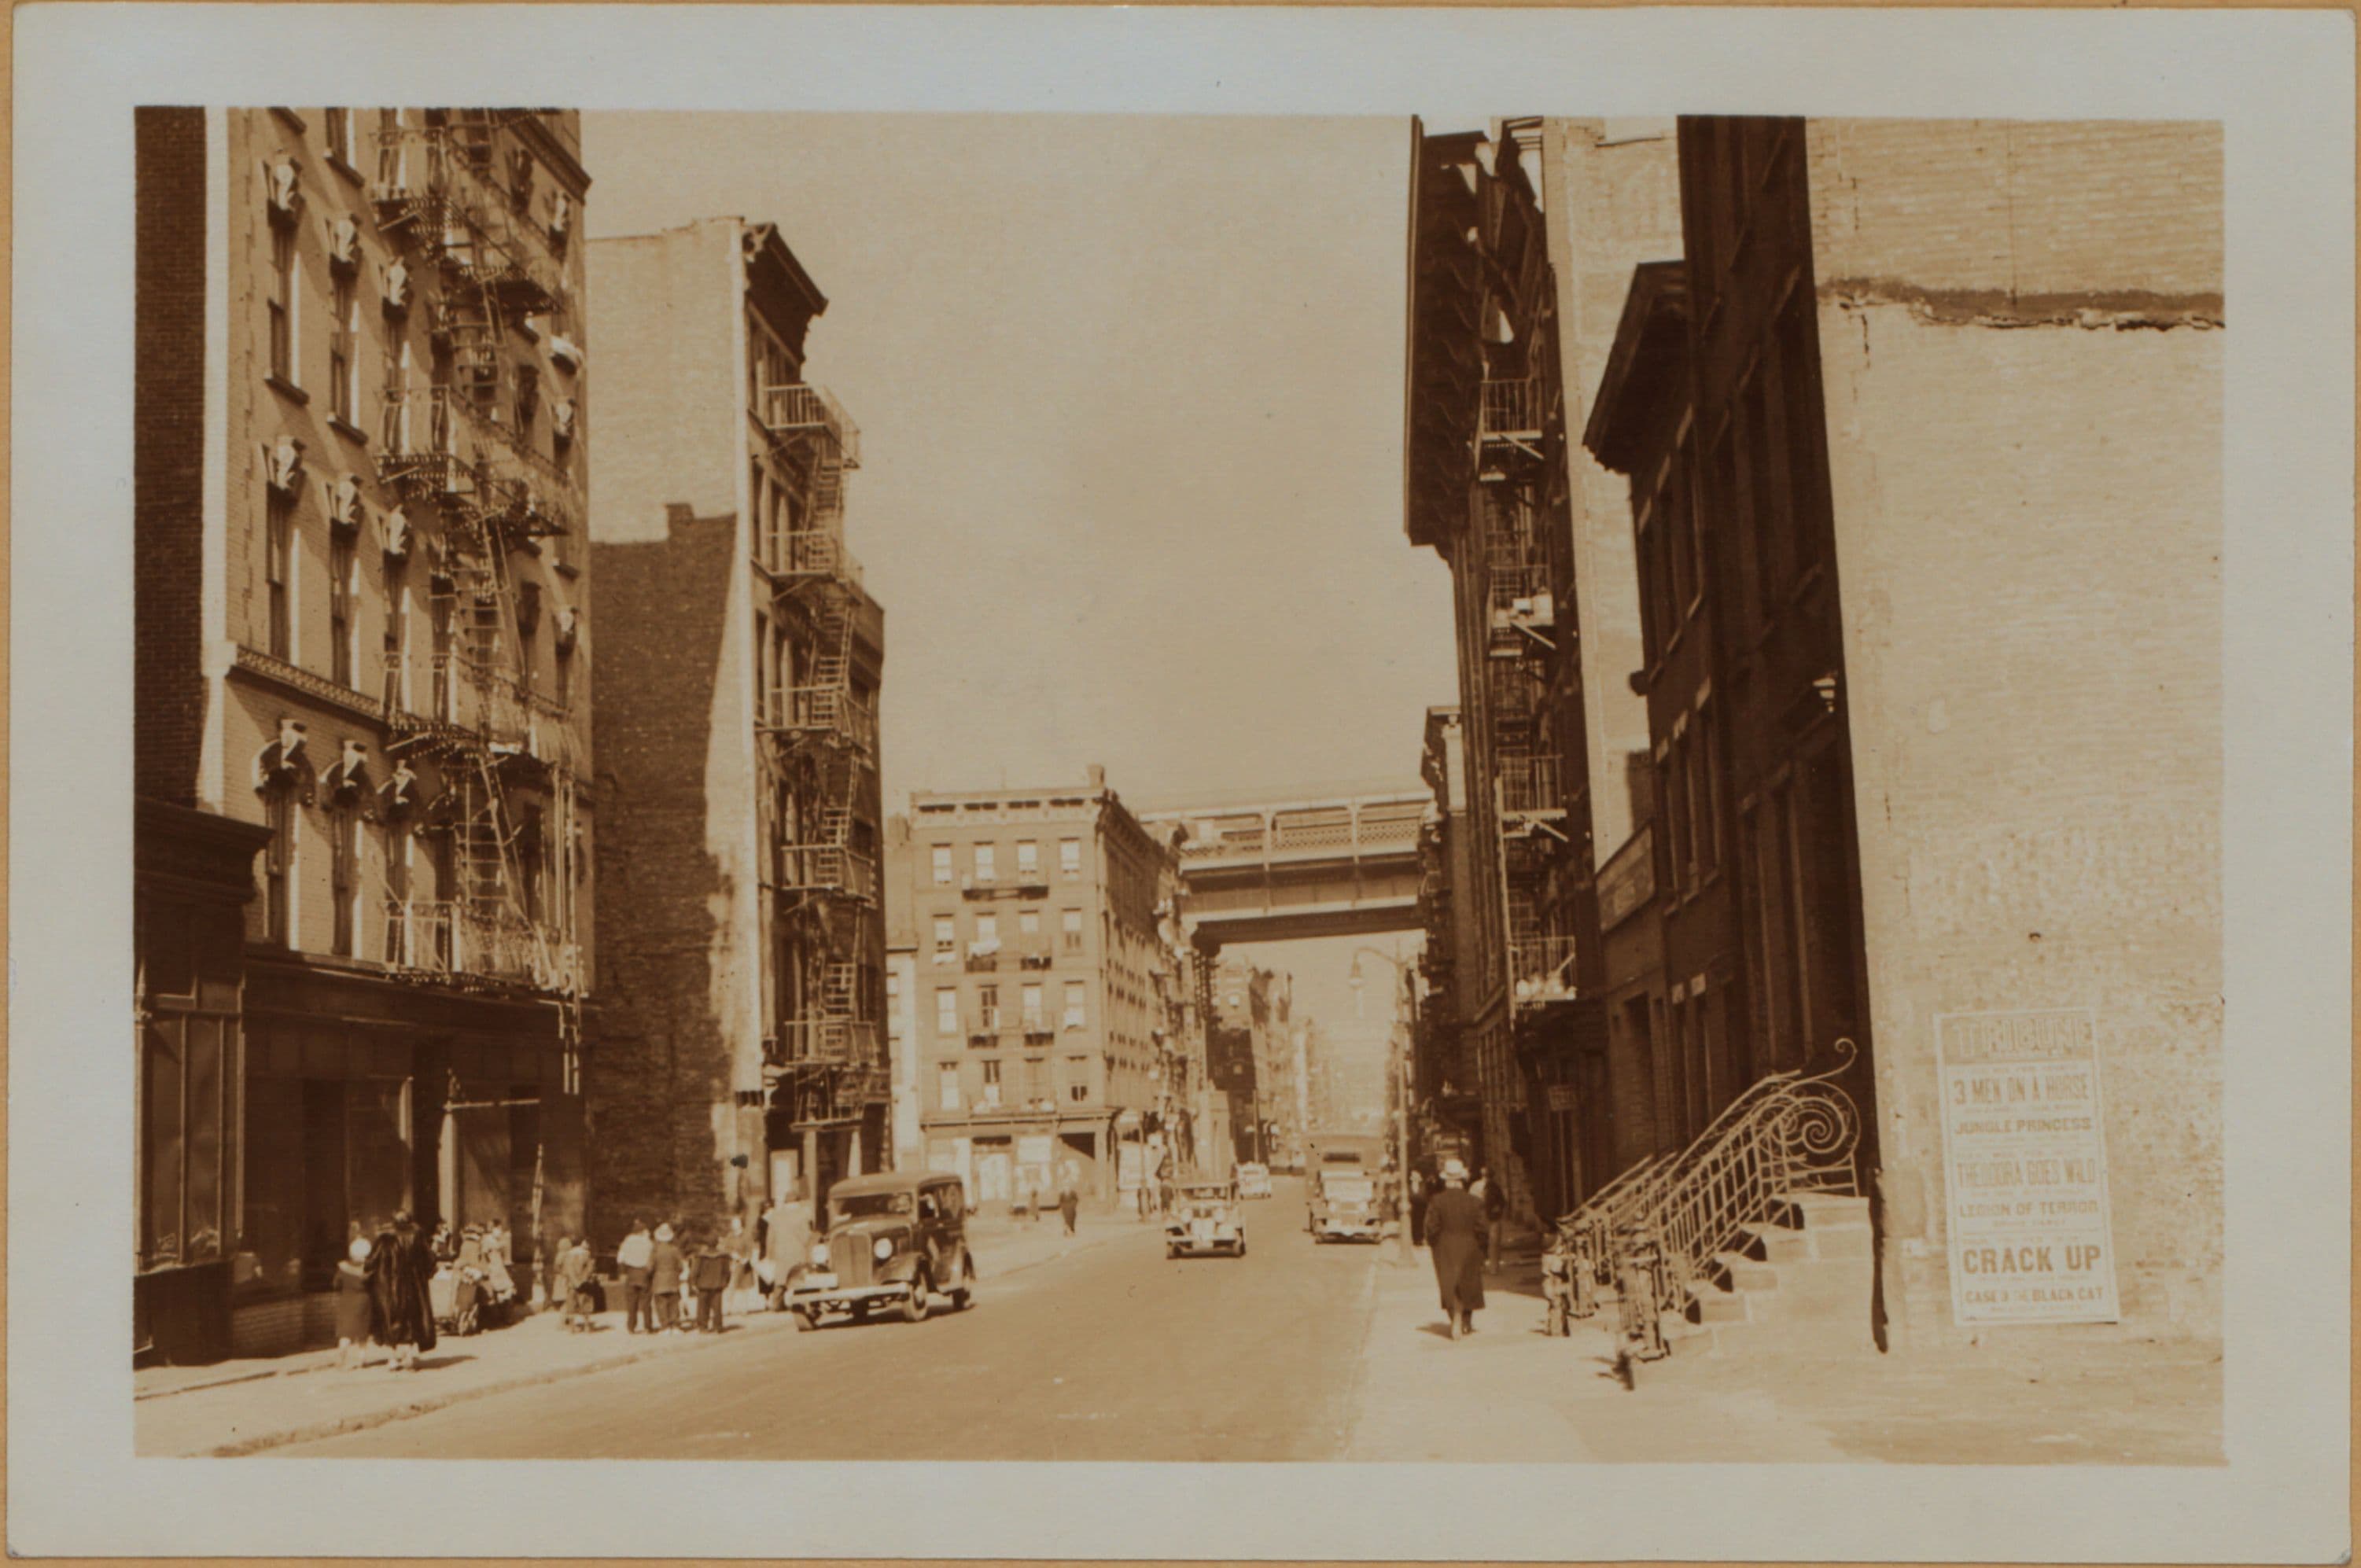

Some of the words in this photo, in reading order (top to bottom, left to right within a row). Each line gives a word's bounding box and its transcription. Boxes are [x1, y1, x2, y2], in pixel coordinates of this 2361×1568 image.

[1954, 1078, 1966, 1104] 3
[1972, 1078, 2002, 1103] MEN
[2007, 1077, 2026, 1102] ON
[2032, 1075, 2041, 1102] A
[2046, 1073, 2090, 1100] HORSE
[1954, 1119, 2012, 1135] JUNGLE
[2016, 1117, 2092, 1132] PRINCESS
[1957, 1161, 2024, 1188] THEODORA
[2026, 1158, 2060, 1185] GOES
[2064, 1158, 2096, 1183] WILD
[1959, 1202, 2010, 1217] LEGION
[2016, 1201, 2032, 1216] OF
[2039, 1199, 2099, 1215] TERROR
[1962, 1245, 2053, 1274] CRACK
[2065, 1244, 2101, 1272] UP
[1965, 1290, 1996, 1303] CASE
[2031, 1288, 2075, 1302] BLACK
[2078, 1286, 2105, 1301] CAT
